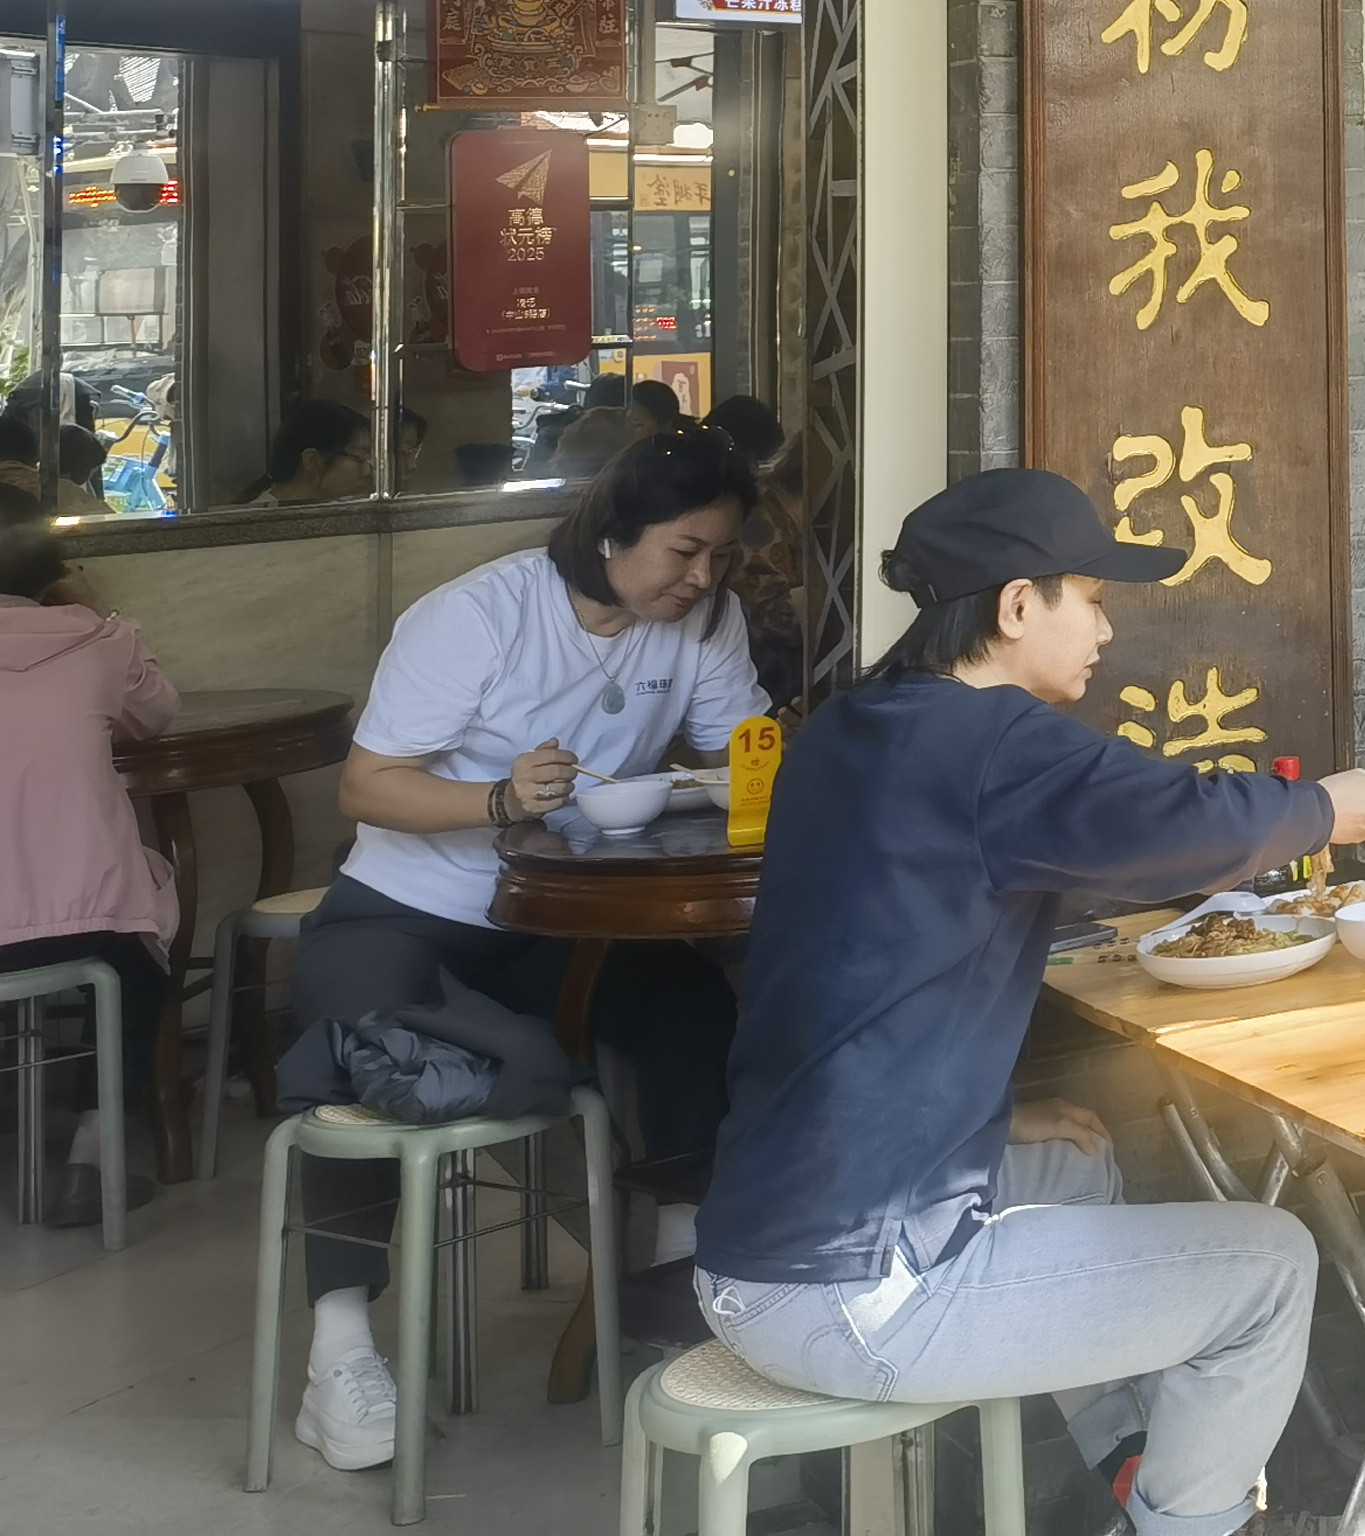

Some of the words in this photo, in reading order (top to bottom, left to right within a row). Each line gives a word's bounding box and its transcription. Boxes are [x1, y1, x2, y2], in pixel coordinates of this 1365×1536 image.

[507, 207, 544, 226] 高德
[507, 248, 545, 262] 2025
[738, 726, 776, 754] 15
